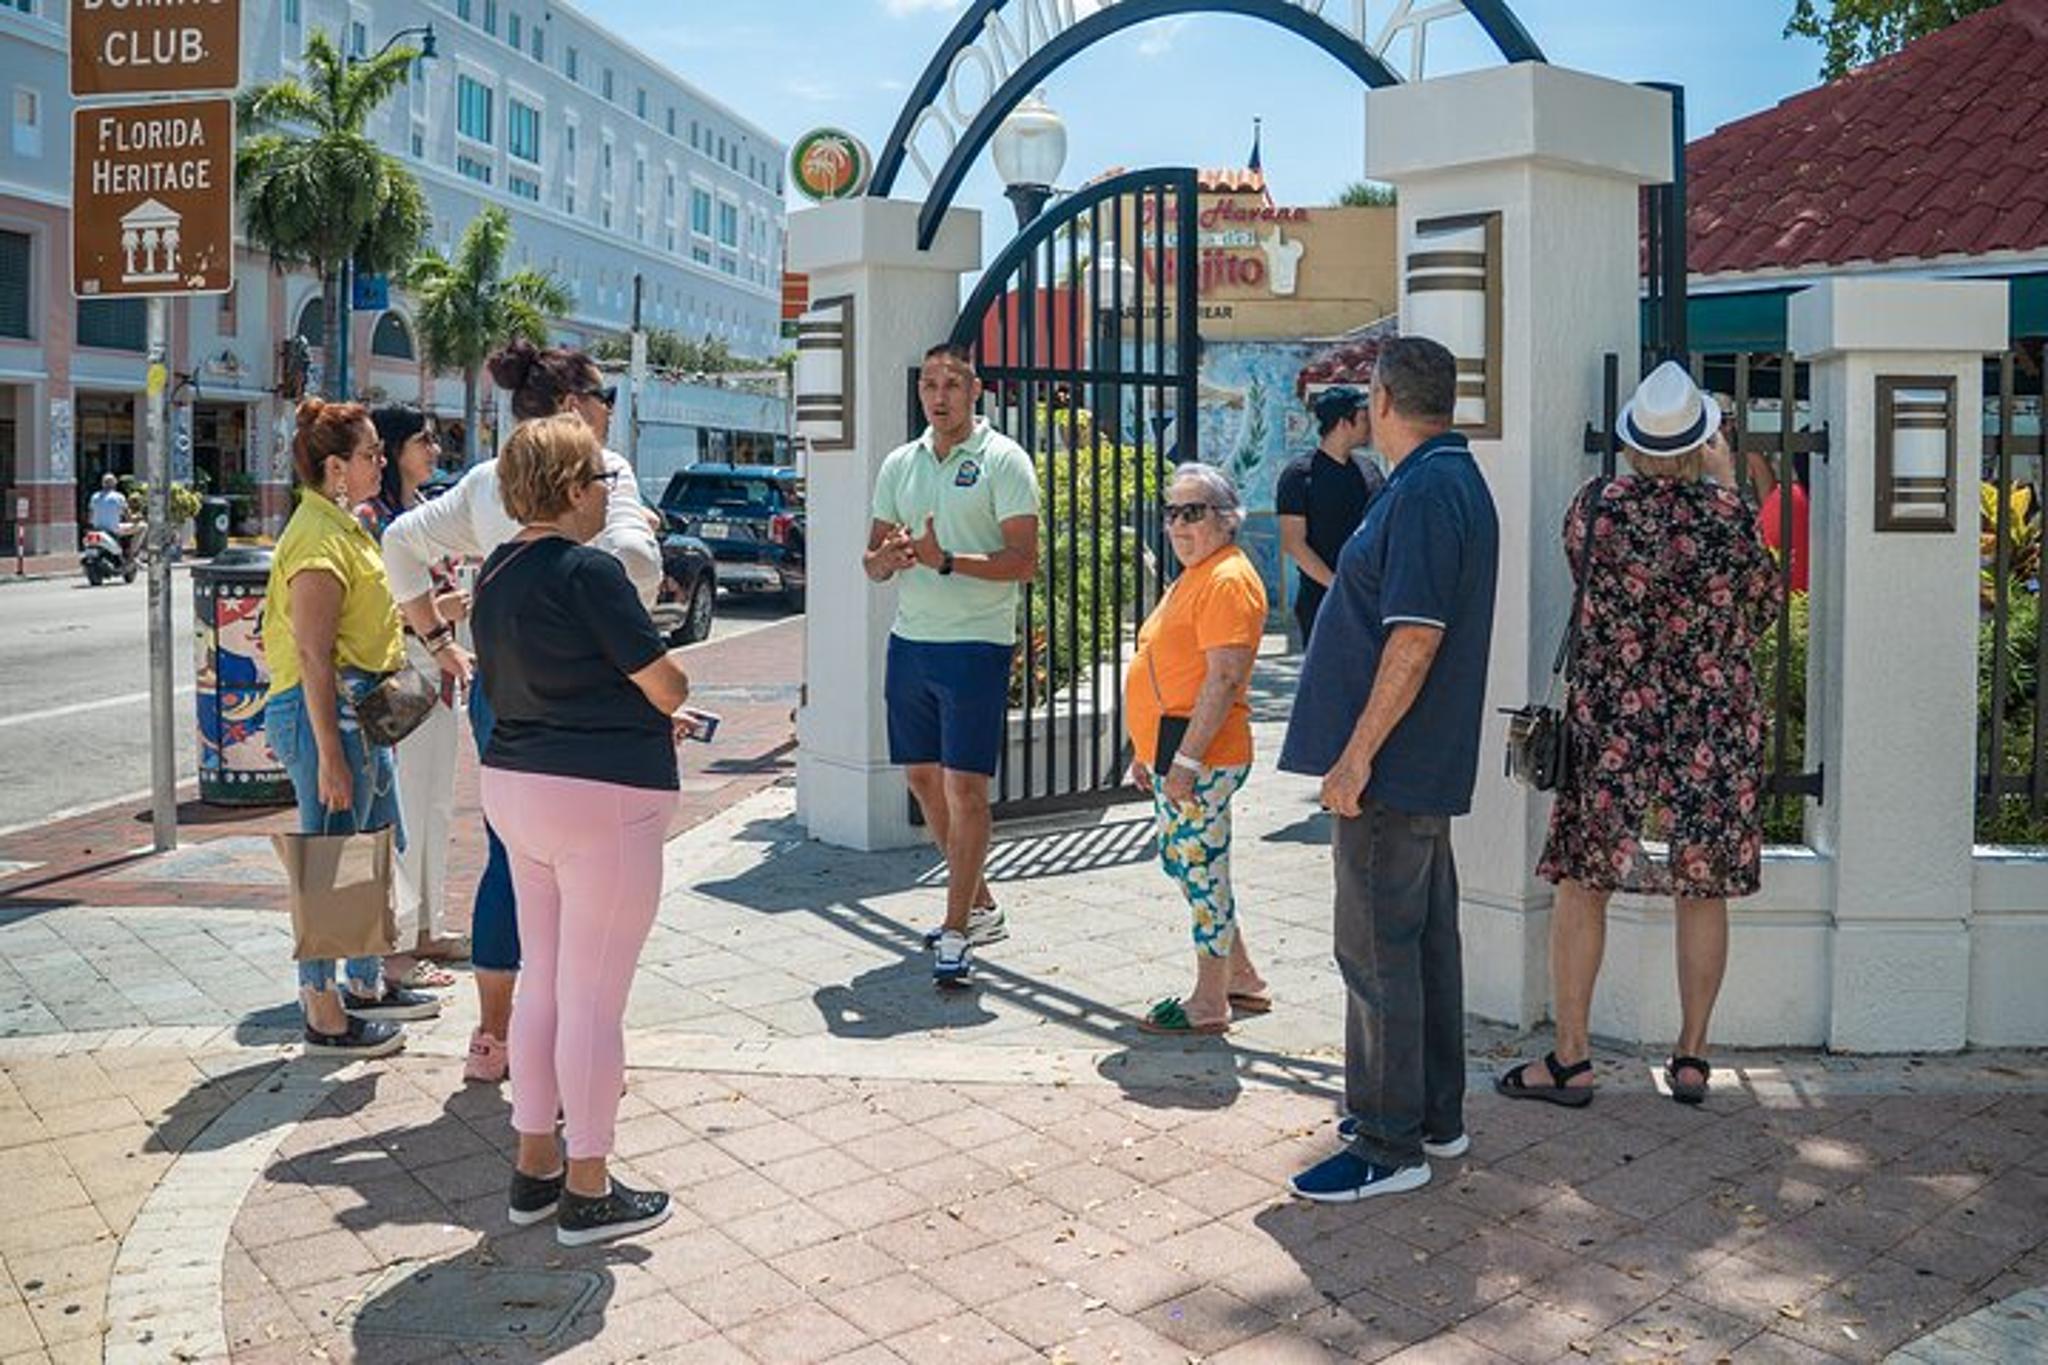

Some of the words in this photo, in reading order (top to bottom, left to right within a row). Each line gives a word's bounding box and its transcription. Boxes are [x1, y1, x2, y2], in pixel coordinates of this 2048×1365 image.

[105, 28, 203, 66] CLUB
[99, 116, 206, 152] FLORIDA
[92, 159, 211, 195] HERITAGE
